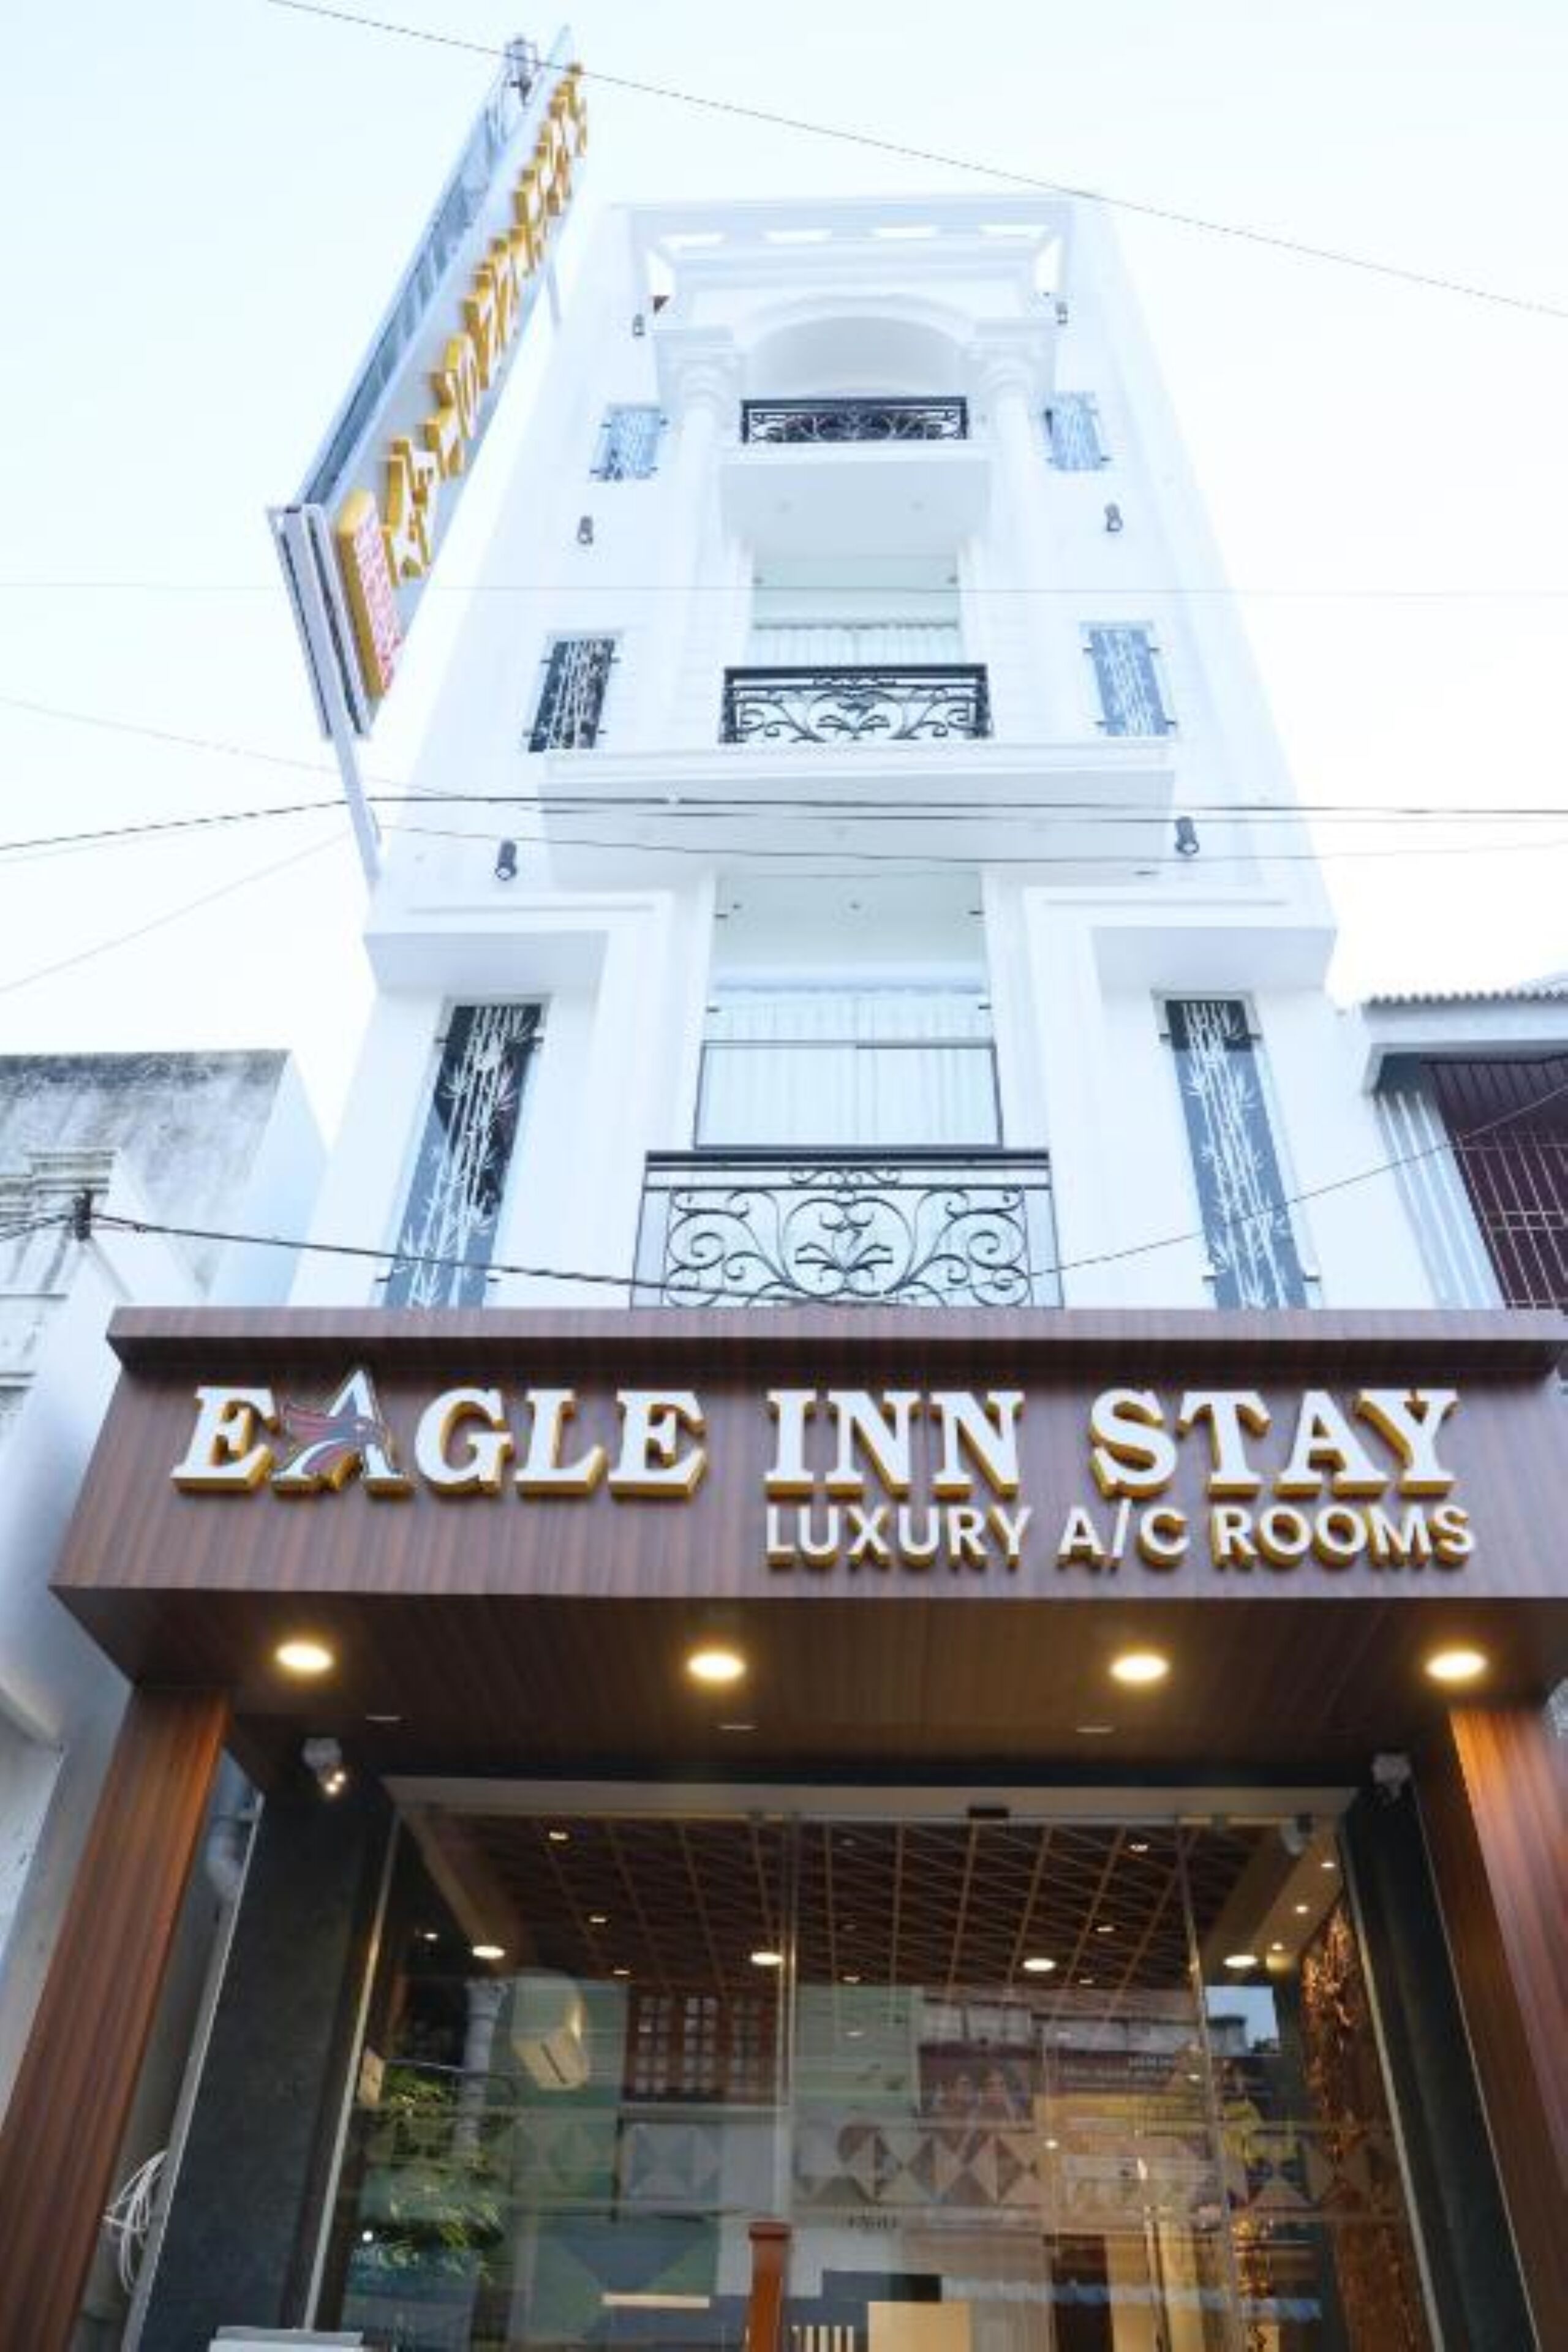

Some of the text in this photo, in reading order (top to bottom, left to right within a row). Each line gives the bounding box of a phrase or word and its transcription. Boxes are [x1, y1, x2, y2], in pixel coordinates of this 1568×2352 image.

[171, 1366, 1459, 1498] EAGLE INN STAY
[766, 1498, 1478, 1569] LUXURY A/C ROOMS
